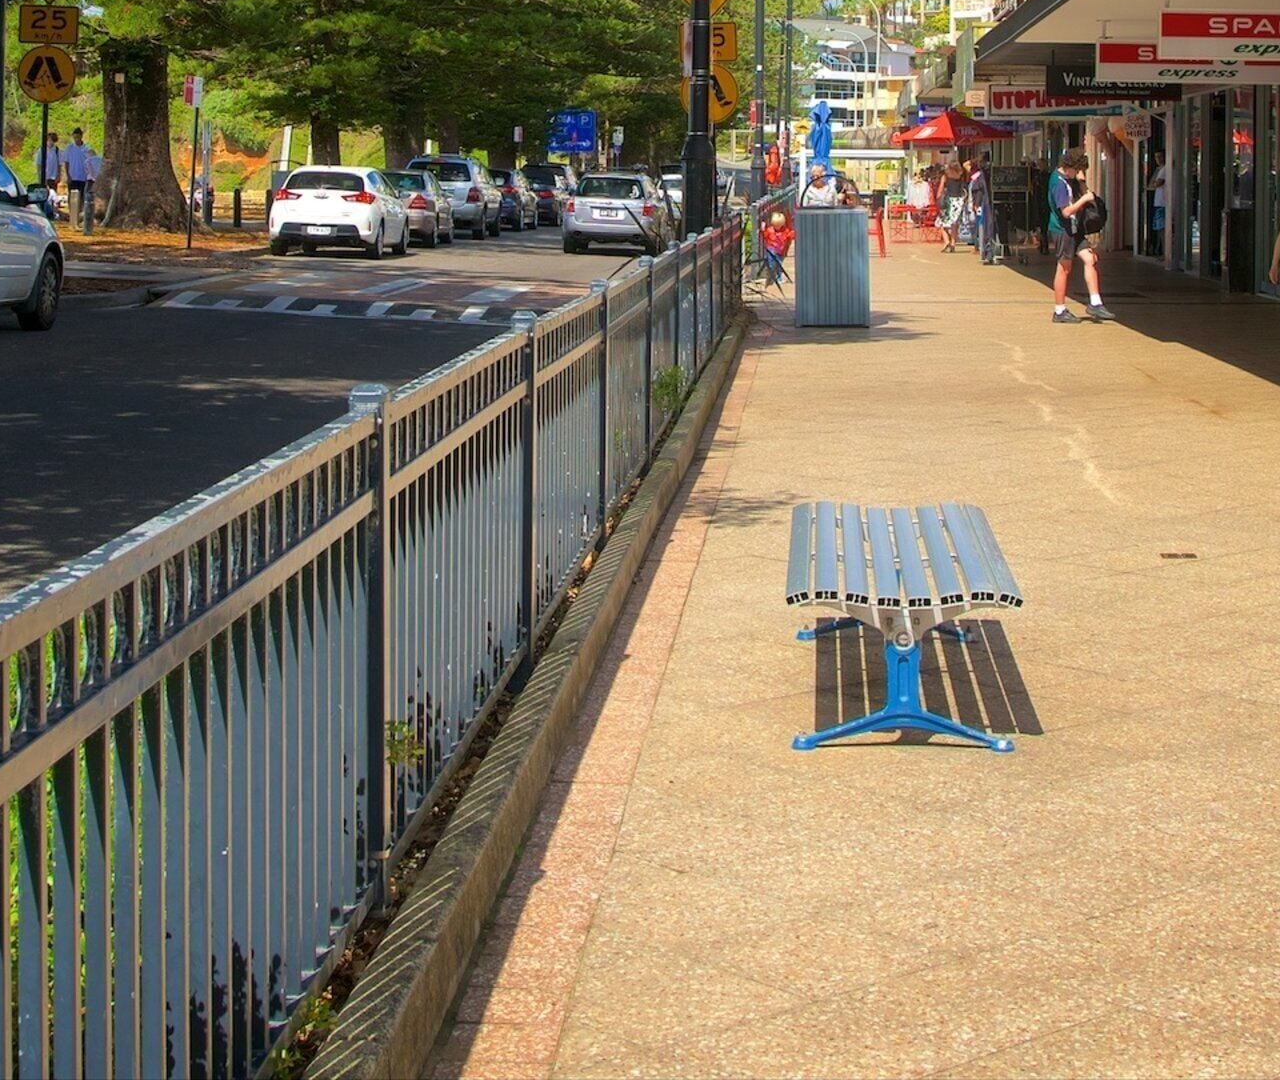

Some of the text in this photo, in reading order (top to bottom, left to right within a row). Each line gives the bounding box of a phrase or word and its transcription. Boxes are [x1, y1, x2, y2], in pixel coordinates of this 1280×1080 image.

[31, 9, 68, 30] 25
[34, 32, 63, 42] km/h
[1157, 67, 1239, 80] express
